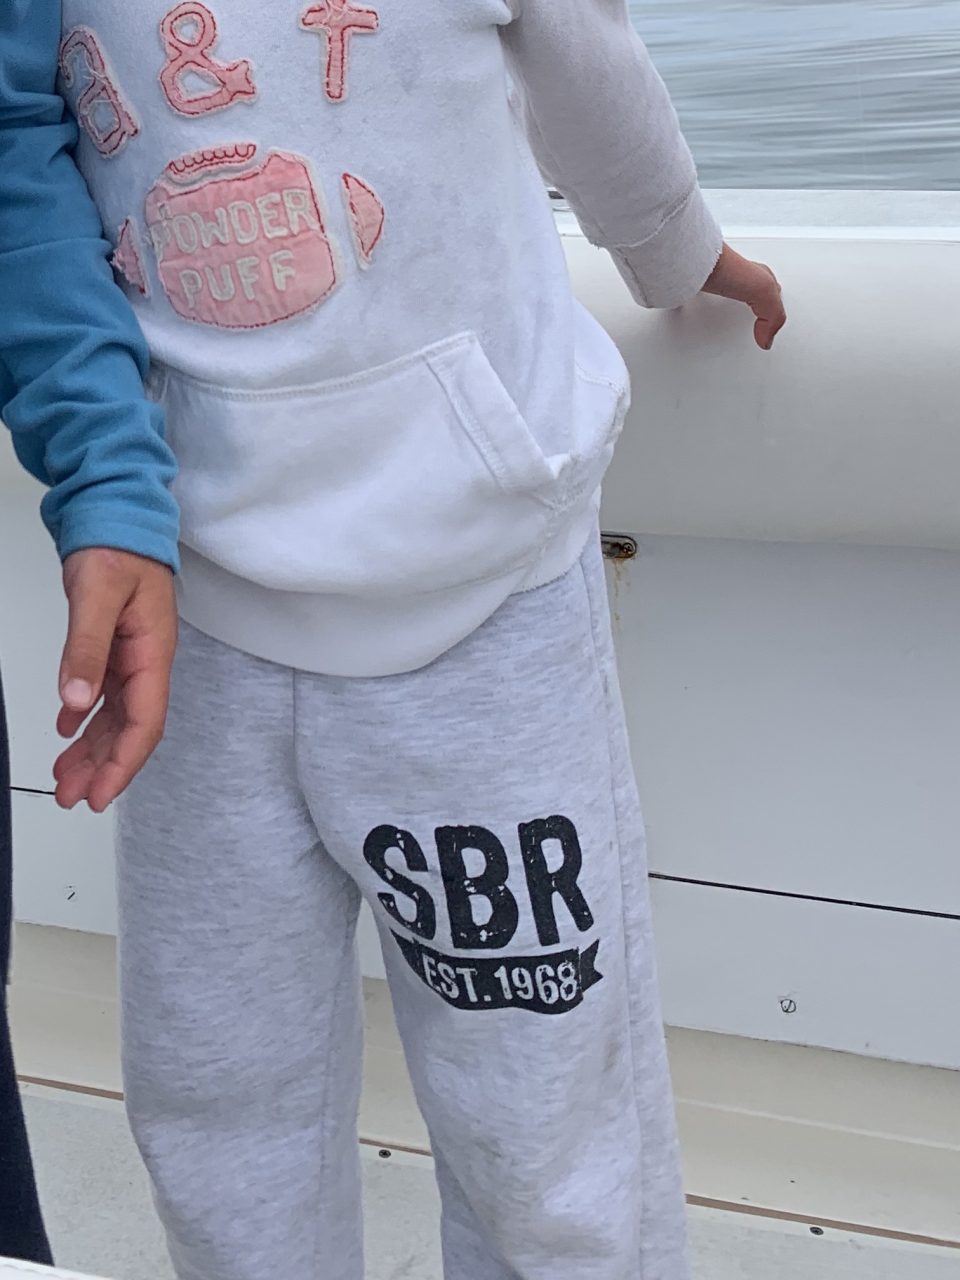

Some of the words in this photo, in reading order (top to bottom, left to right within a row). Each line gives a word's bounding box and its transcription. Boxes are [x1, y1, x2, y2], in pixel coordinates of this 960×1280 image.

[160, 0, 256, 117] &
[150, 188, 319, 262] POWDER
[179, 250, 296, 308] PUFF
[363, 815, 594, 949] SBR
